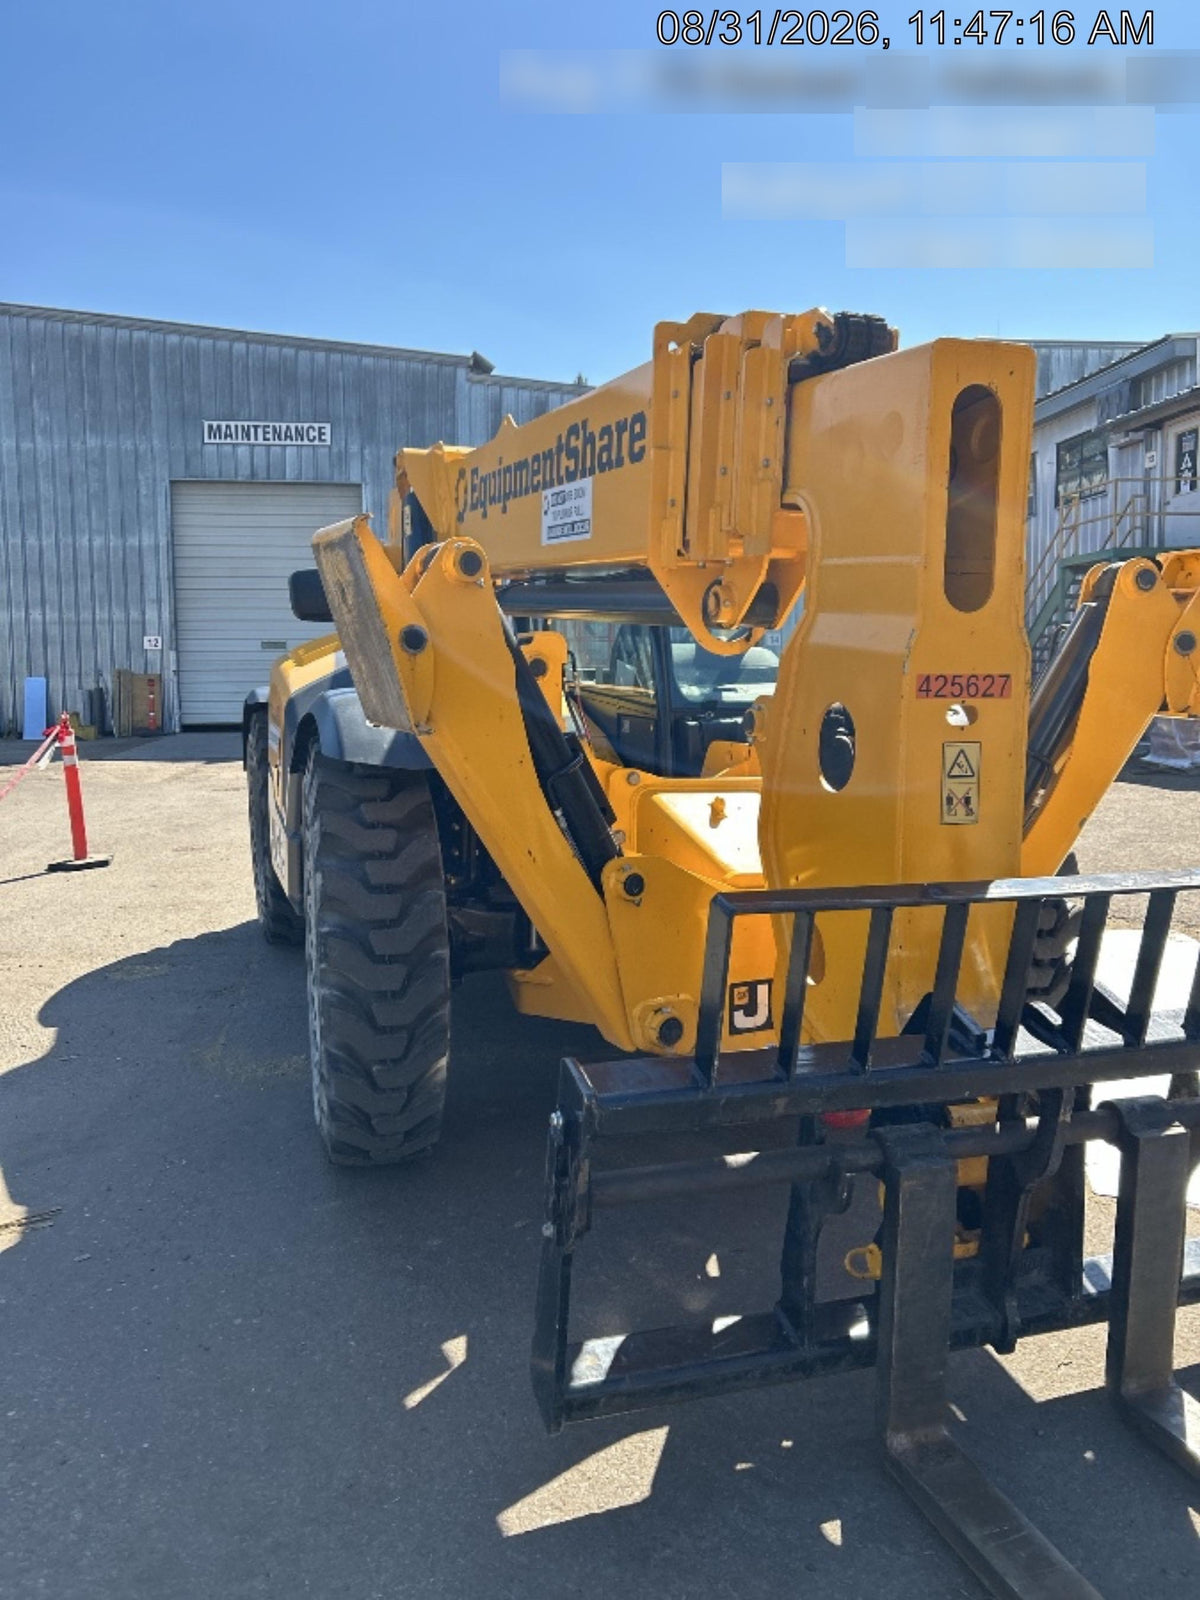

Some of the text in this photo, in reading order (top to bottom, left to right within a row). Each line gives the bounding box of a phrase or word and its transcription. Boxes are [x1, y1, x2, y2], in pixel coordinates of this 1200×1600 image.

[207, 422, 327, 443] MAINTENANCE
[469, 410, 647, 515] EquipmentShare
[918, 673, 1012, 699] 425627
